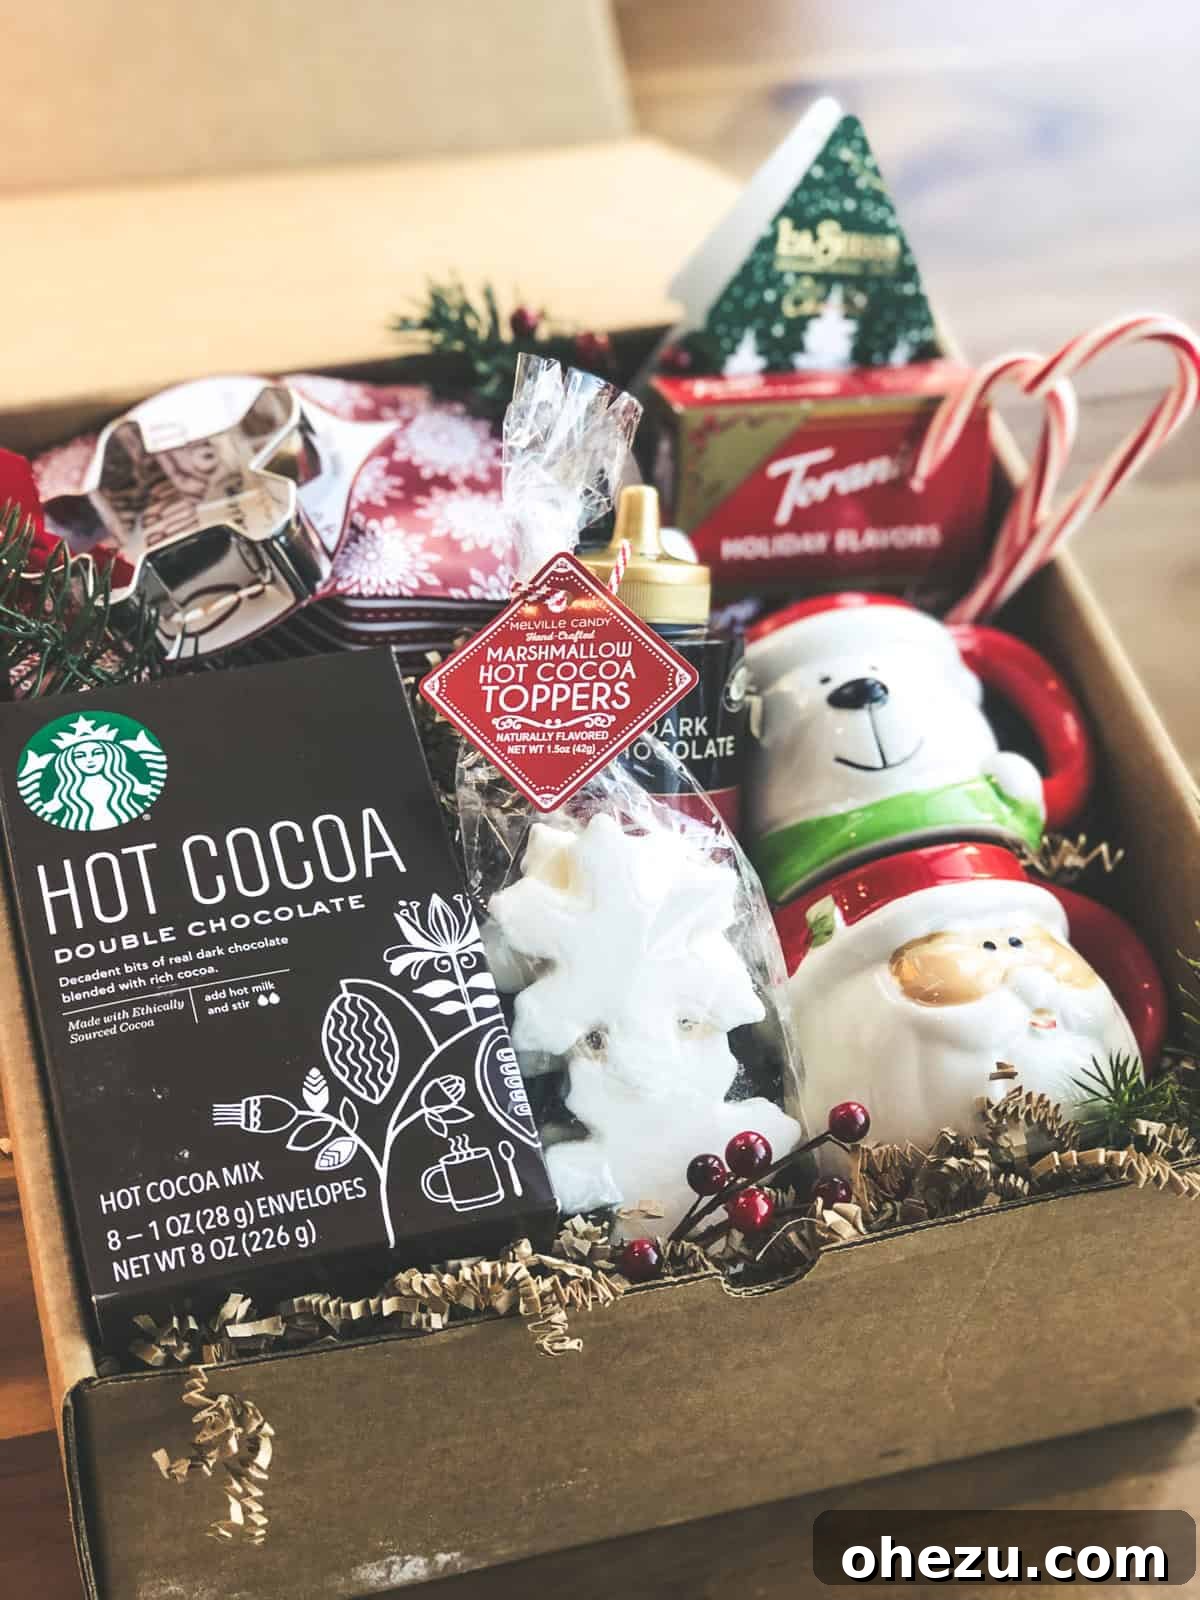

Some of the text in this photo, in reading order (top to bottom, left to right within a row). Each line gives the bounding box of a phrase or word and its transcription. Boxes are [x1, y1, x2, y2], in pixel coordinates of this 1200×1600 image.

[721, 523, 941, 561] HOLIDAY FLAVORS
[486, 641, 633, 662] MARSHMALLOW
[479, 660, 637, 684] HOT COCOA
[481, 681, 631, 713] TOPPERS
[496, 730, 609, 743] NATURALLY FLAVORED
[507, 744, 528, 755] NET
[528, 744, 545, 755] WT
[572, 743, 596, 755] (42g)
[623, 736, 735, 761] OOLATE
[37, 807, 407, 935] HOT COCOA
[54, 894, 366, 964] DOUBLE CHOCOLATE
[59, 935, 289, 988] Decadent bits of real dark chocolate
[61, 965, 219, 1004] blended with rich cocoa.
[204, 981, 275, 1002] add hot milk
[68, 999, 185, 1032] Made with Ethically
[207, 999, 250, 1016] and stir
[70, 1019, 155, 1045] Sourced Cocoa
[100, 1160, 264, 1214] HOT COCOA MIX
[107, 1229, 122, 1250] 8
[148, 1220, 161, 1241] 1
[166, 1213, 193, 1237] OZ
[256, 1177, 367, 1218] ENVELOPES
[112, 1253, 151, 1283] NET
[153, 1246, 187, 1273] WT
[191, 1243, 206, 1264] 8
[209, 1235, 239, 1260] OZ
[241, 1224, 290, 1257] (226
